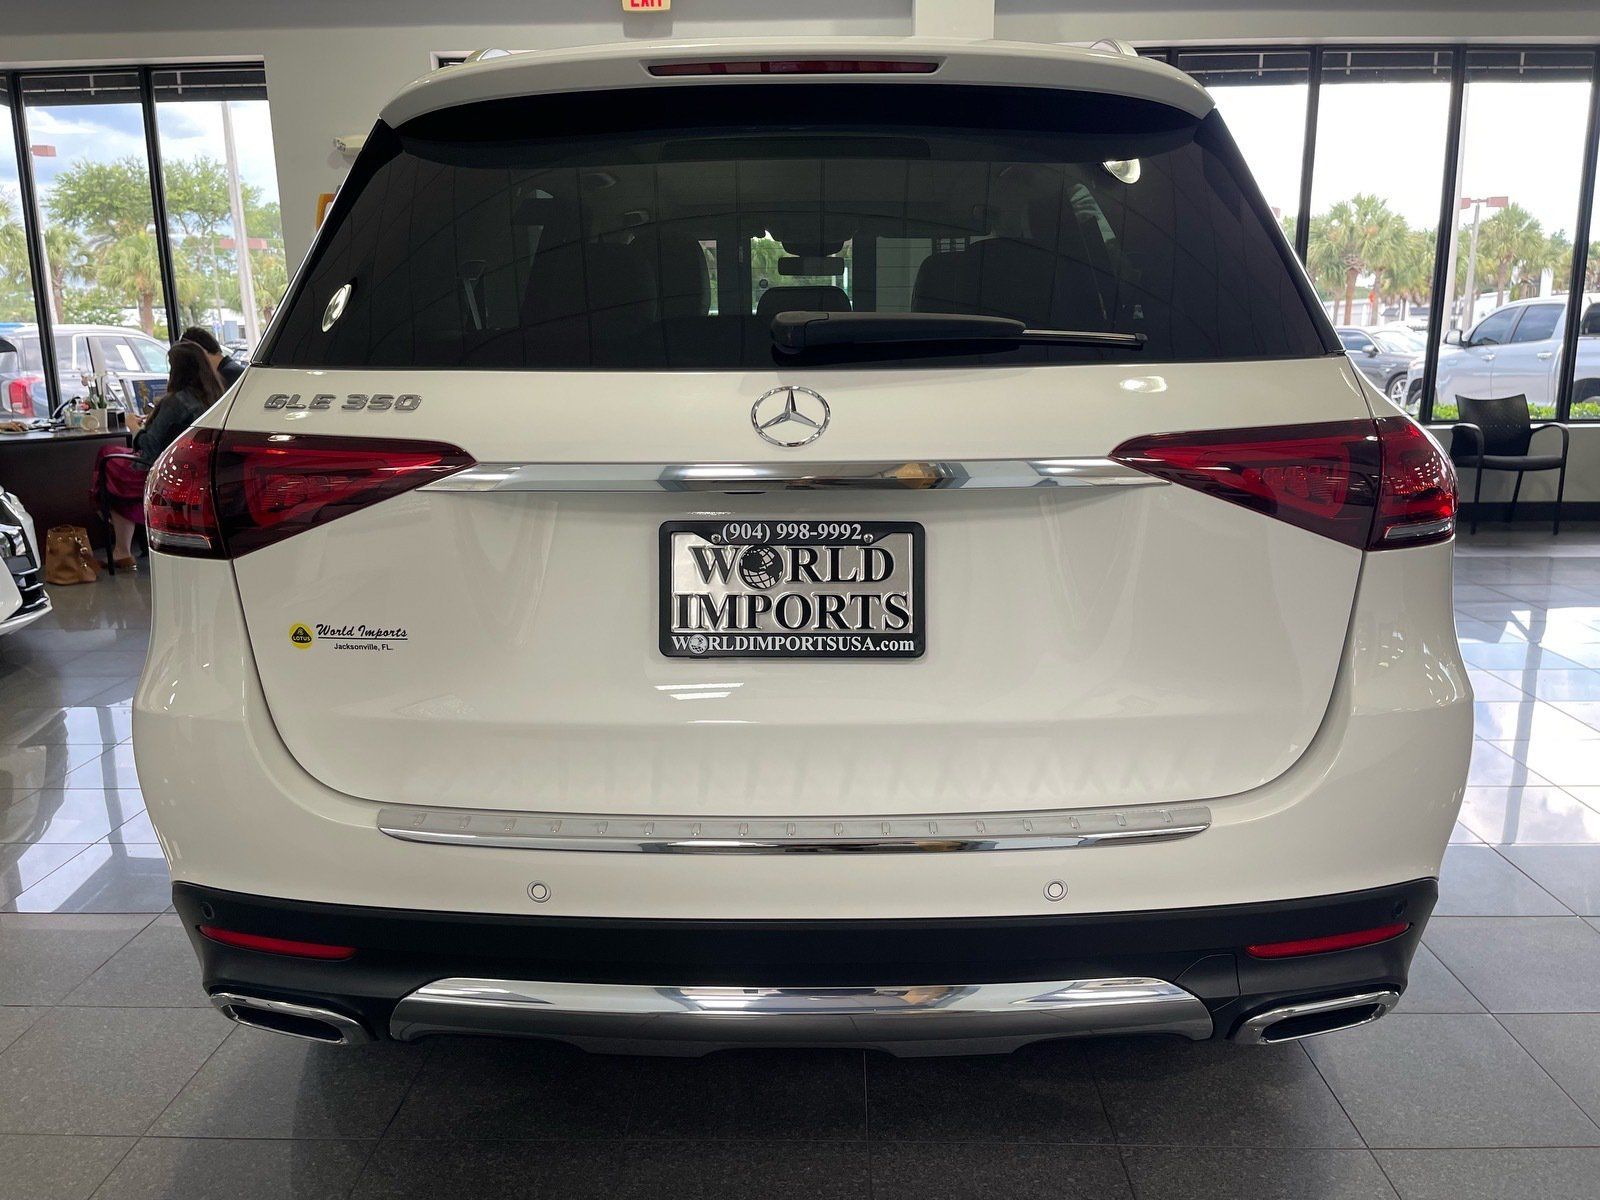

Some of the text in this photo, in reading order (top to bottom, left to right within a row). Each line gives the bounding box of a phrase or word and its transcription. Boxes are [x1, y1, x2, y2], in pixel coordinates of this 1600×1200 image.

[264, 393, 422, 411] GLE 350
[722, 523, 862, 543] (904) 998-9992
[673, 592, 910, 631] IMPORTS
[315, 623, 408, 639] World Imports
[334, 643, 380, 651] Jacksonville,
